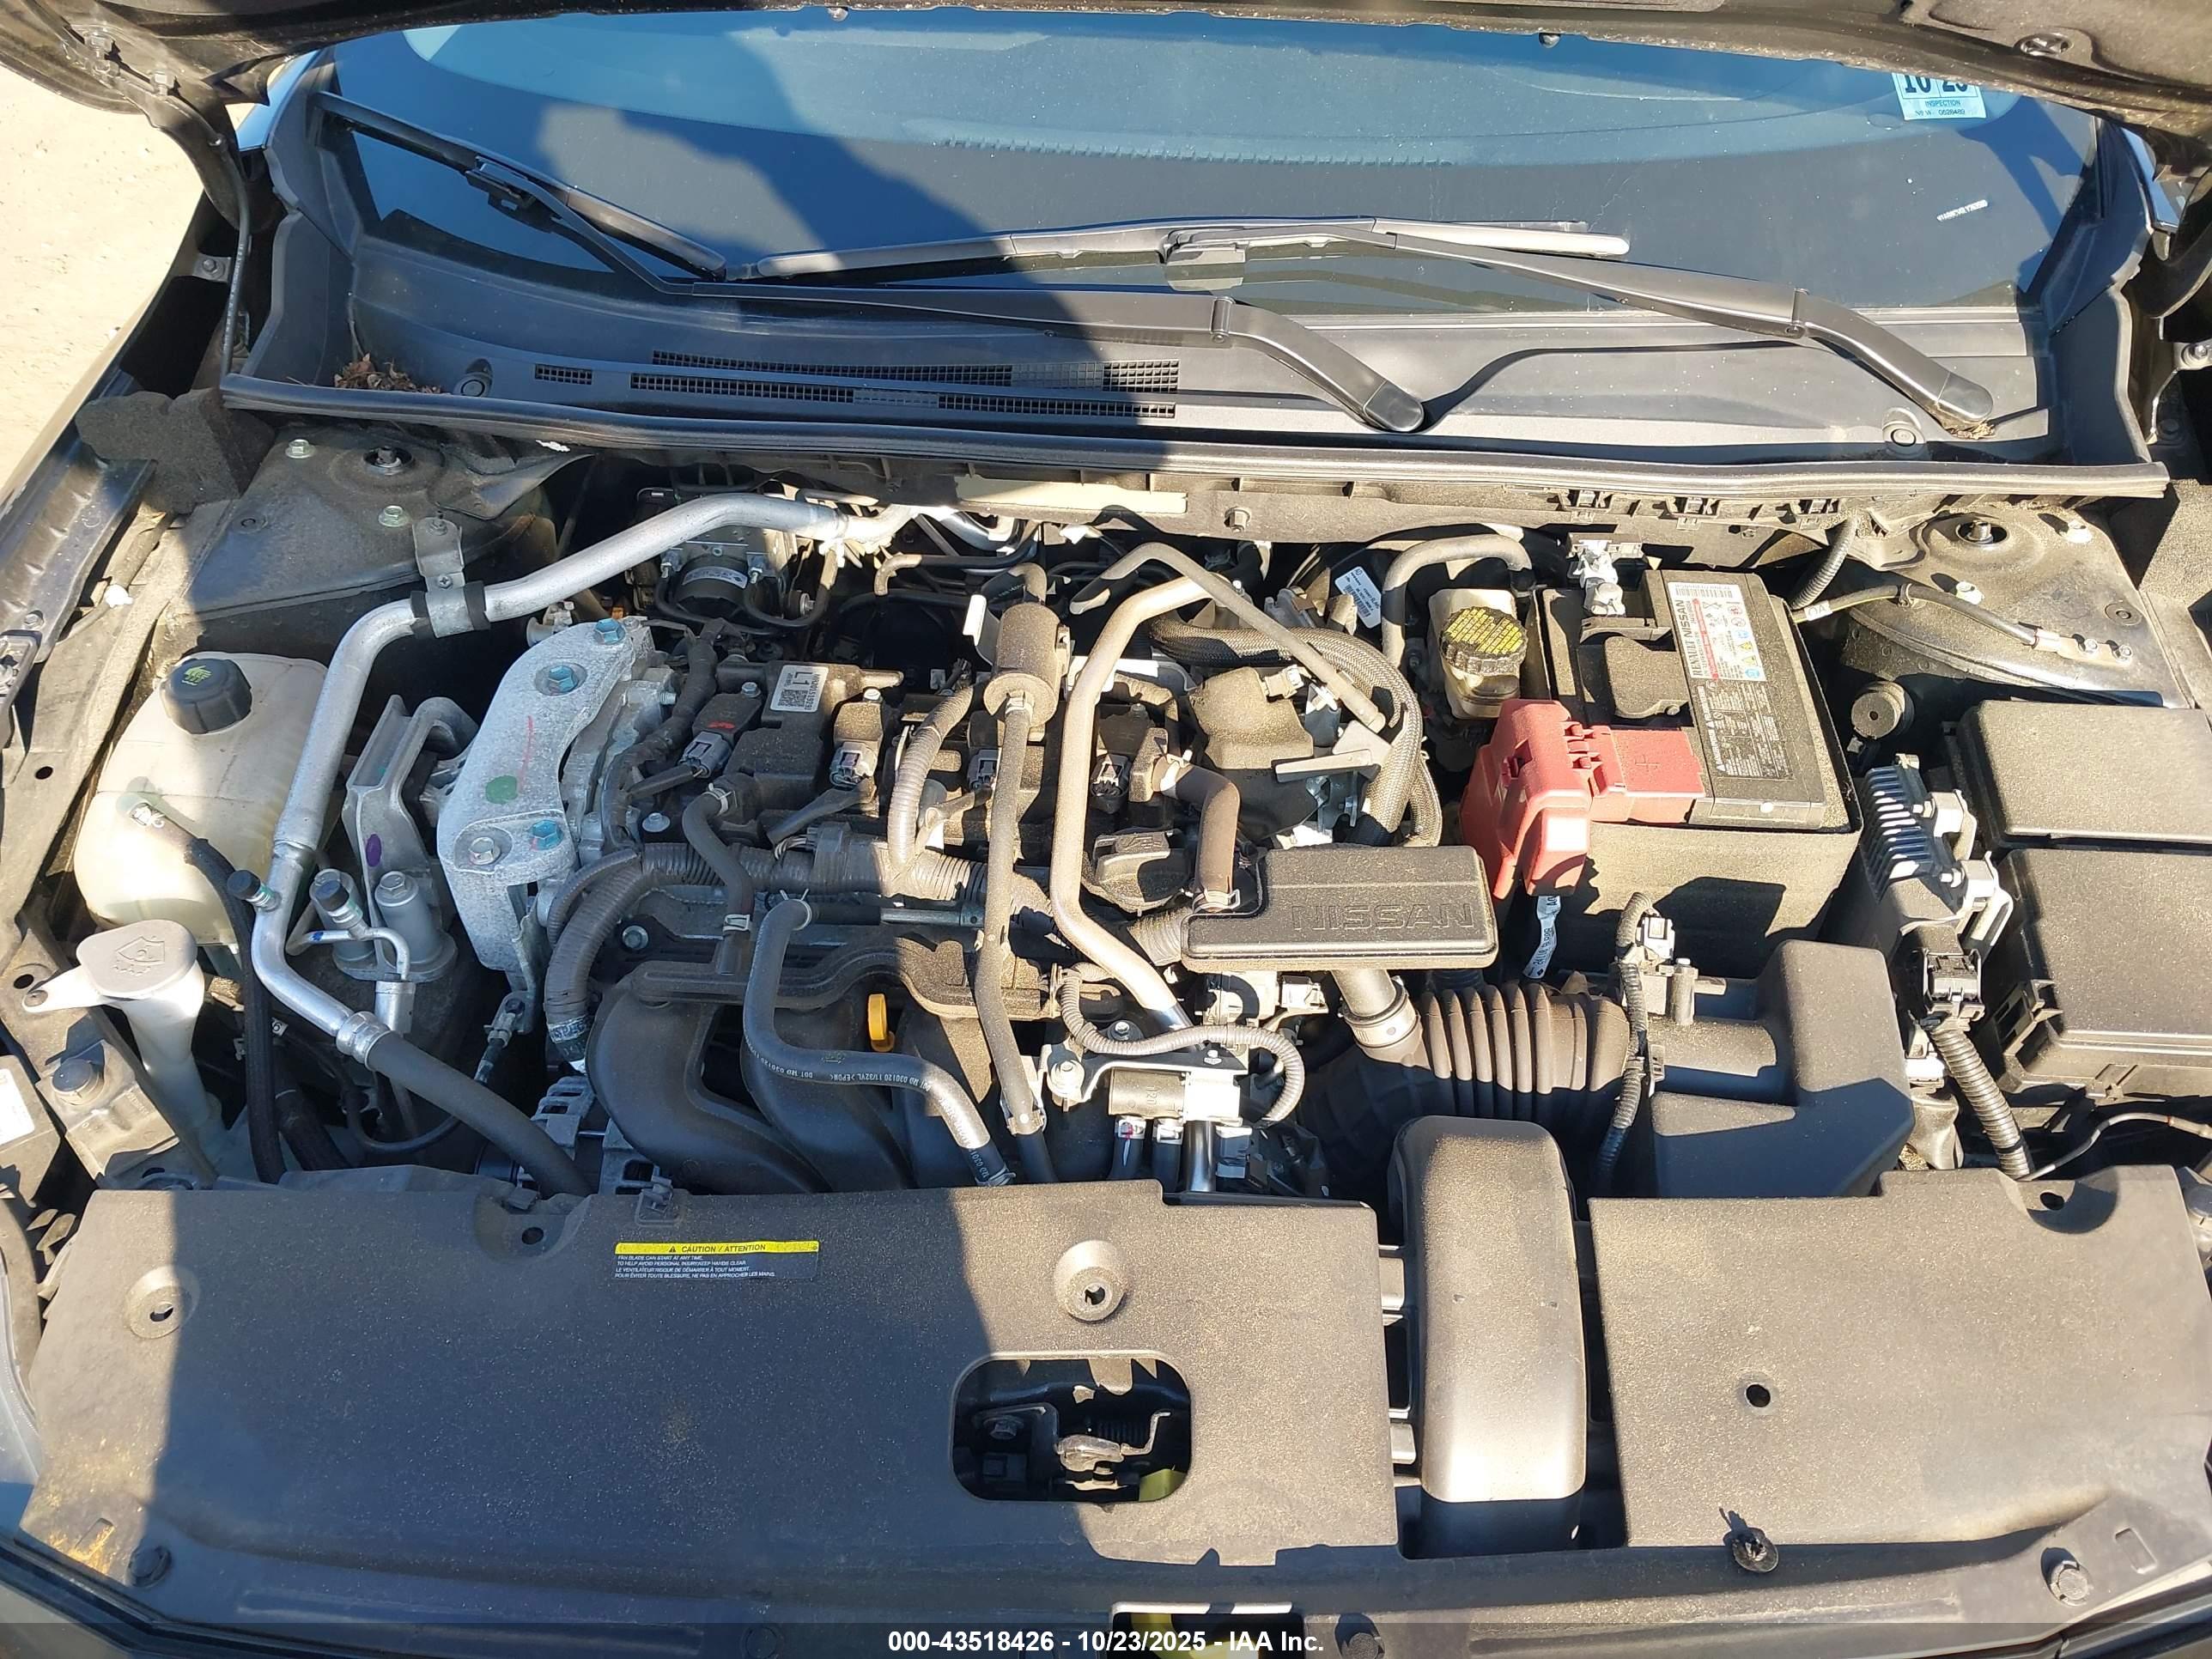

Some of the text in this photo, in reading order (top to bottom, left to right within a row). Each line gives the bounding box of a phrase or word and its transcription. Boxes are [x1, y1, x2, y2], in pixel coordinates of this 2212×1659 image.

[1674, 599, 1692, 636] NISSAN
[1685, 640, 1703, 677] RENAULT
[1291, 903, 1475, 931] NISSAN
[724, 1243, 766, 1252] ATTENTION
